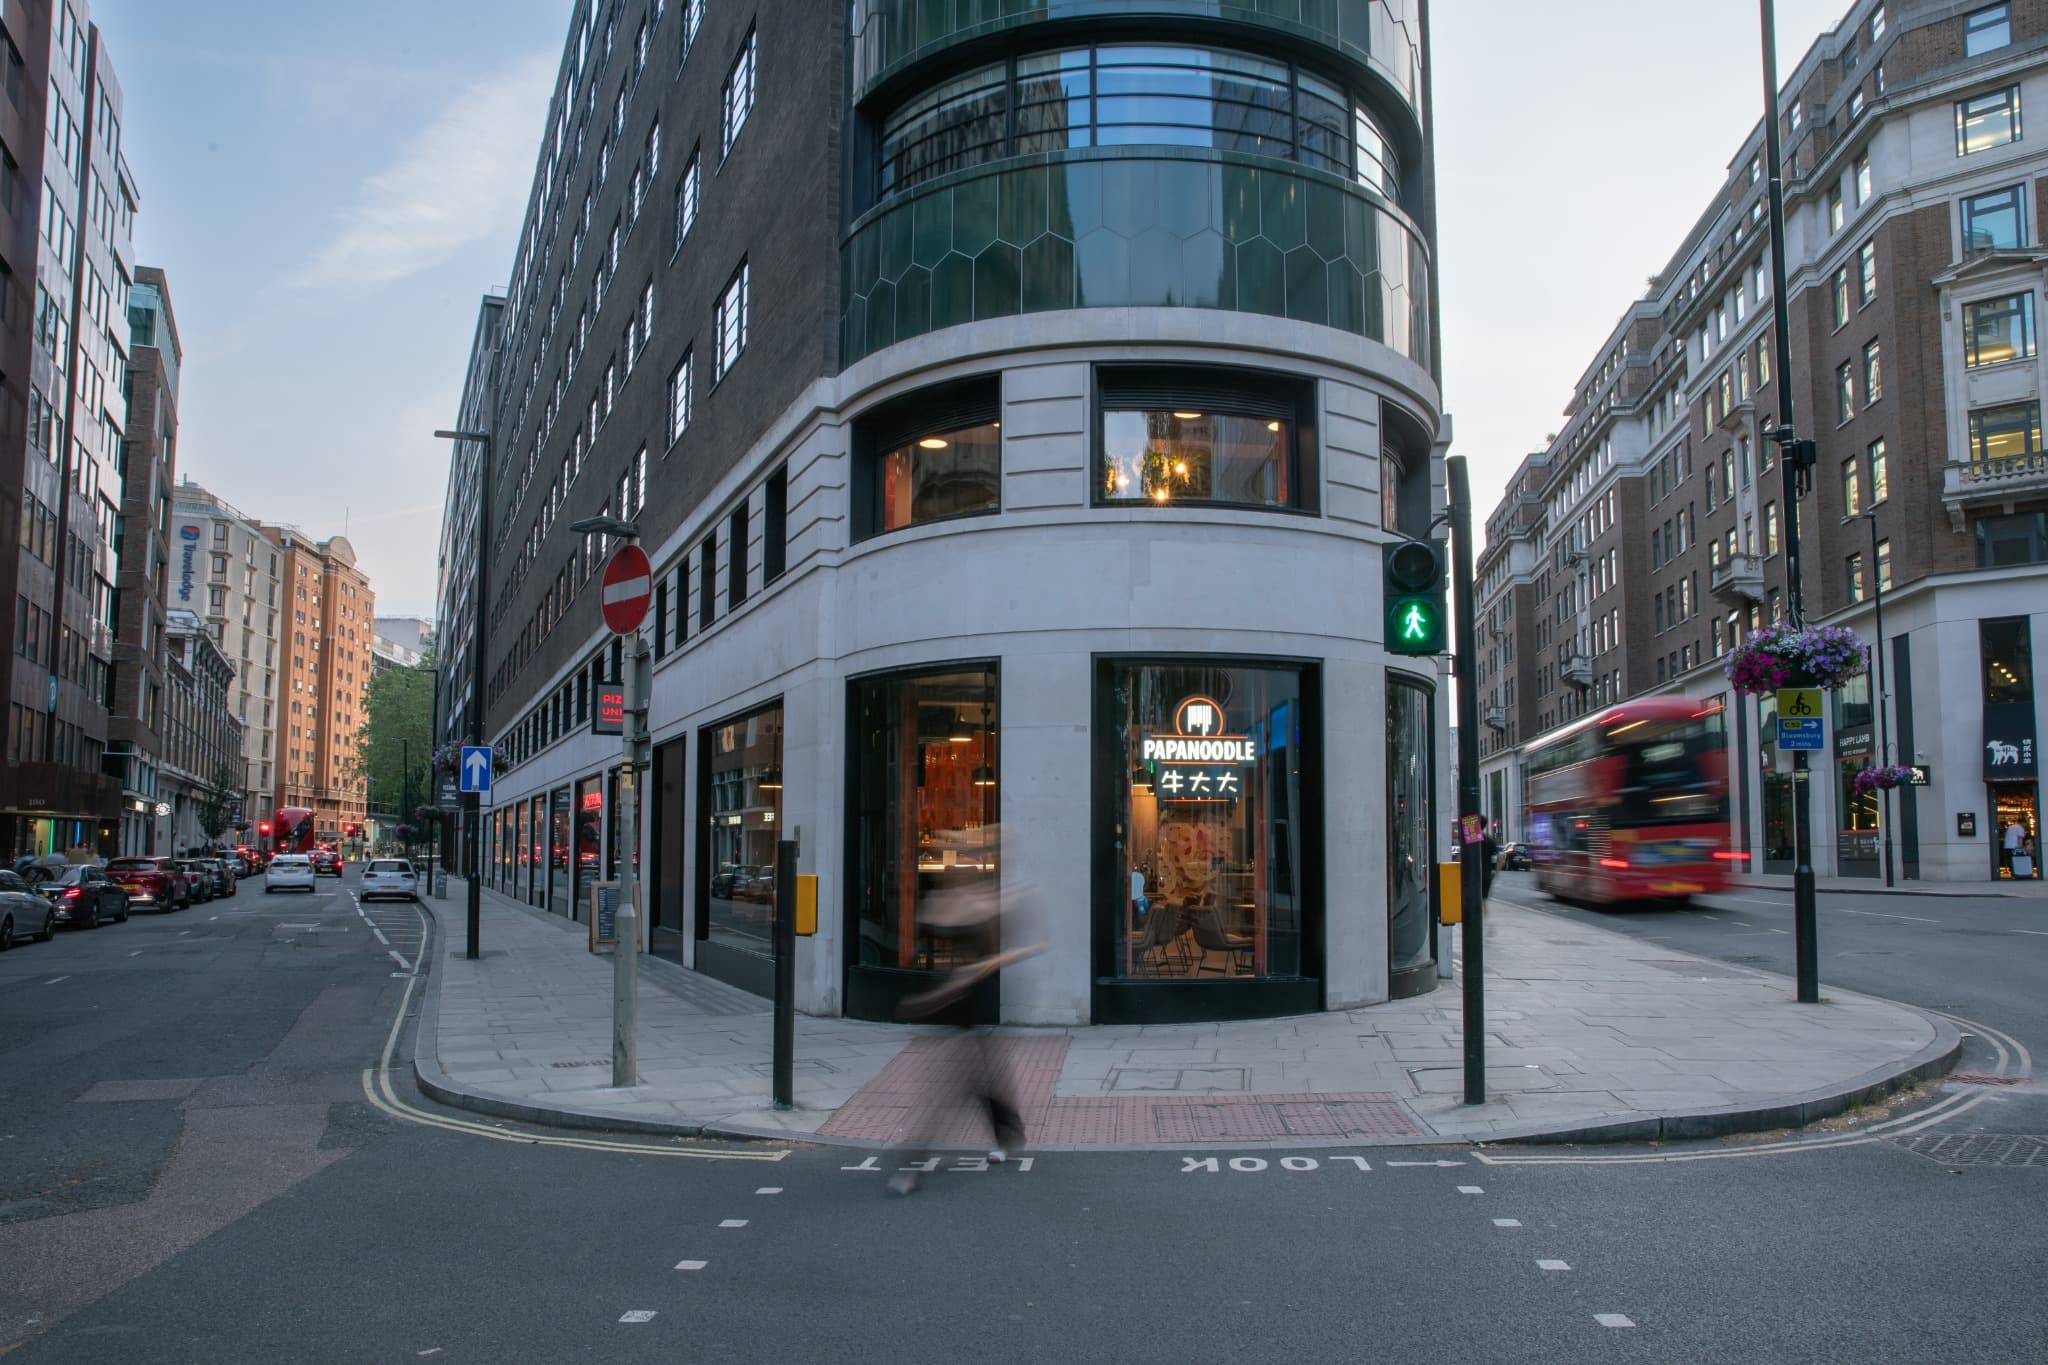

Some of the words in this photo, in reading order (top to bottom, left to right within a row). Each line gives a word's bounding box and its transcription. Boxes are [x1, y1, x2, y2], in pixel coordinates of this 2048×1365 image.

[179, 542, 197, 602] Travelodge
[603, 695, 622, 705] PIZ
[602, 708, 623, 716] UNI
[1781, 732, 1820, 740] Bloomsbury
[1839, 736, 1855, 747] HAPPY
[1855, 734, 1870, 744] LAMB
[1143, 740, 1255, 761] PAPANOODLE
[840, 1156, 1035, 1172] LEFT
[1181, 1156, 1373, 1172] LOOK
